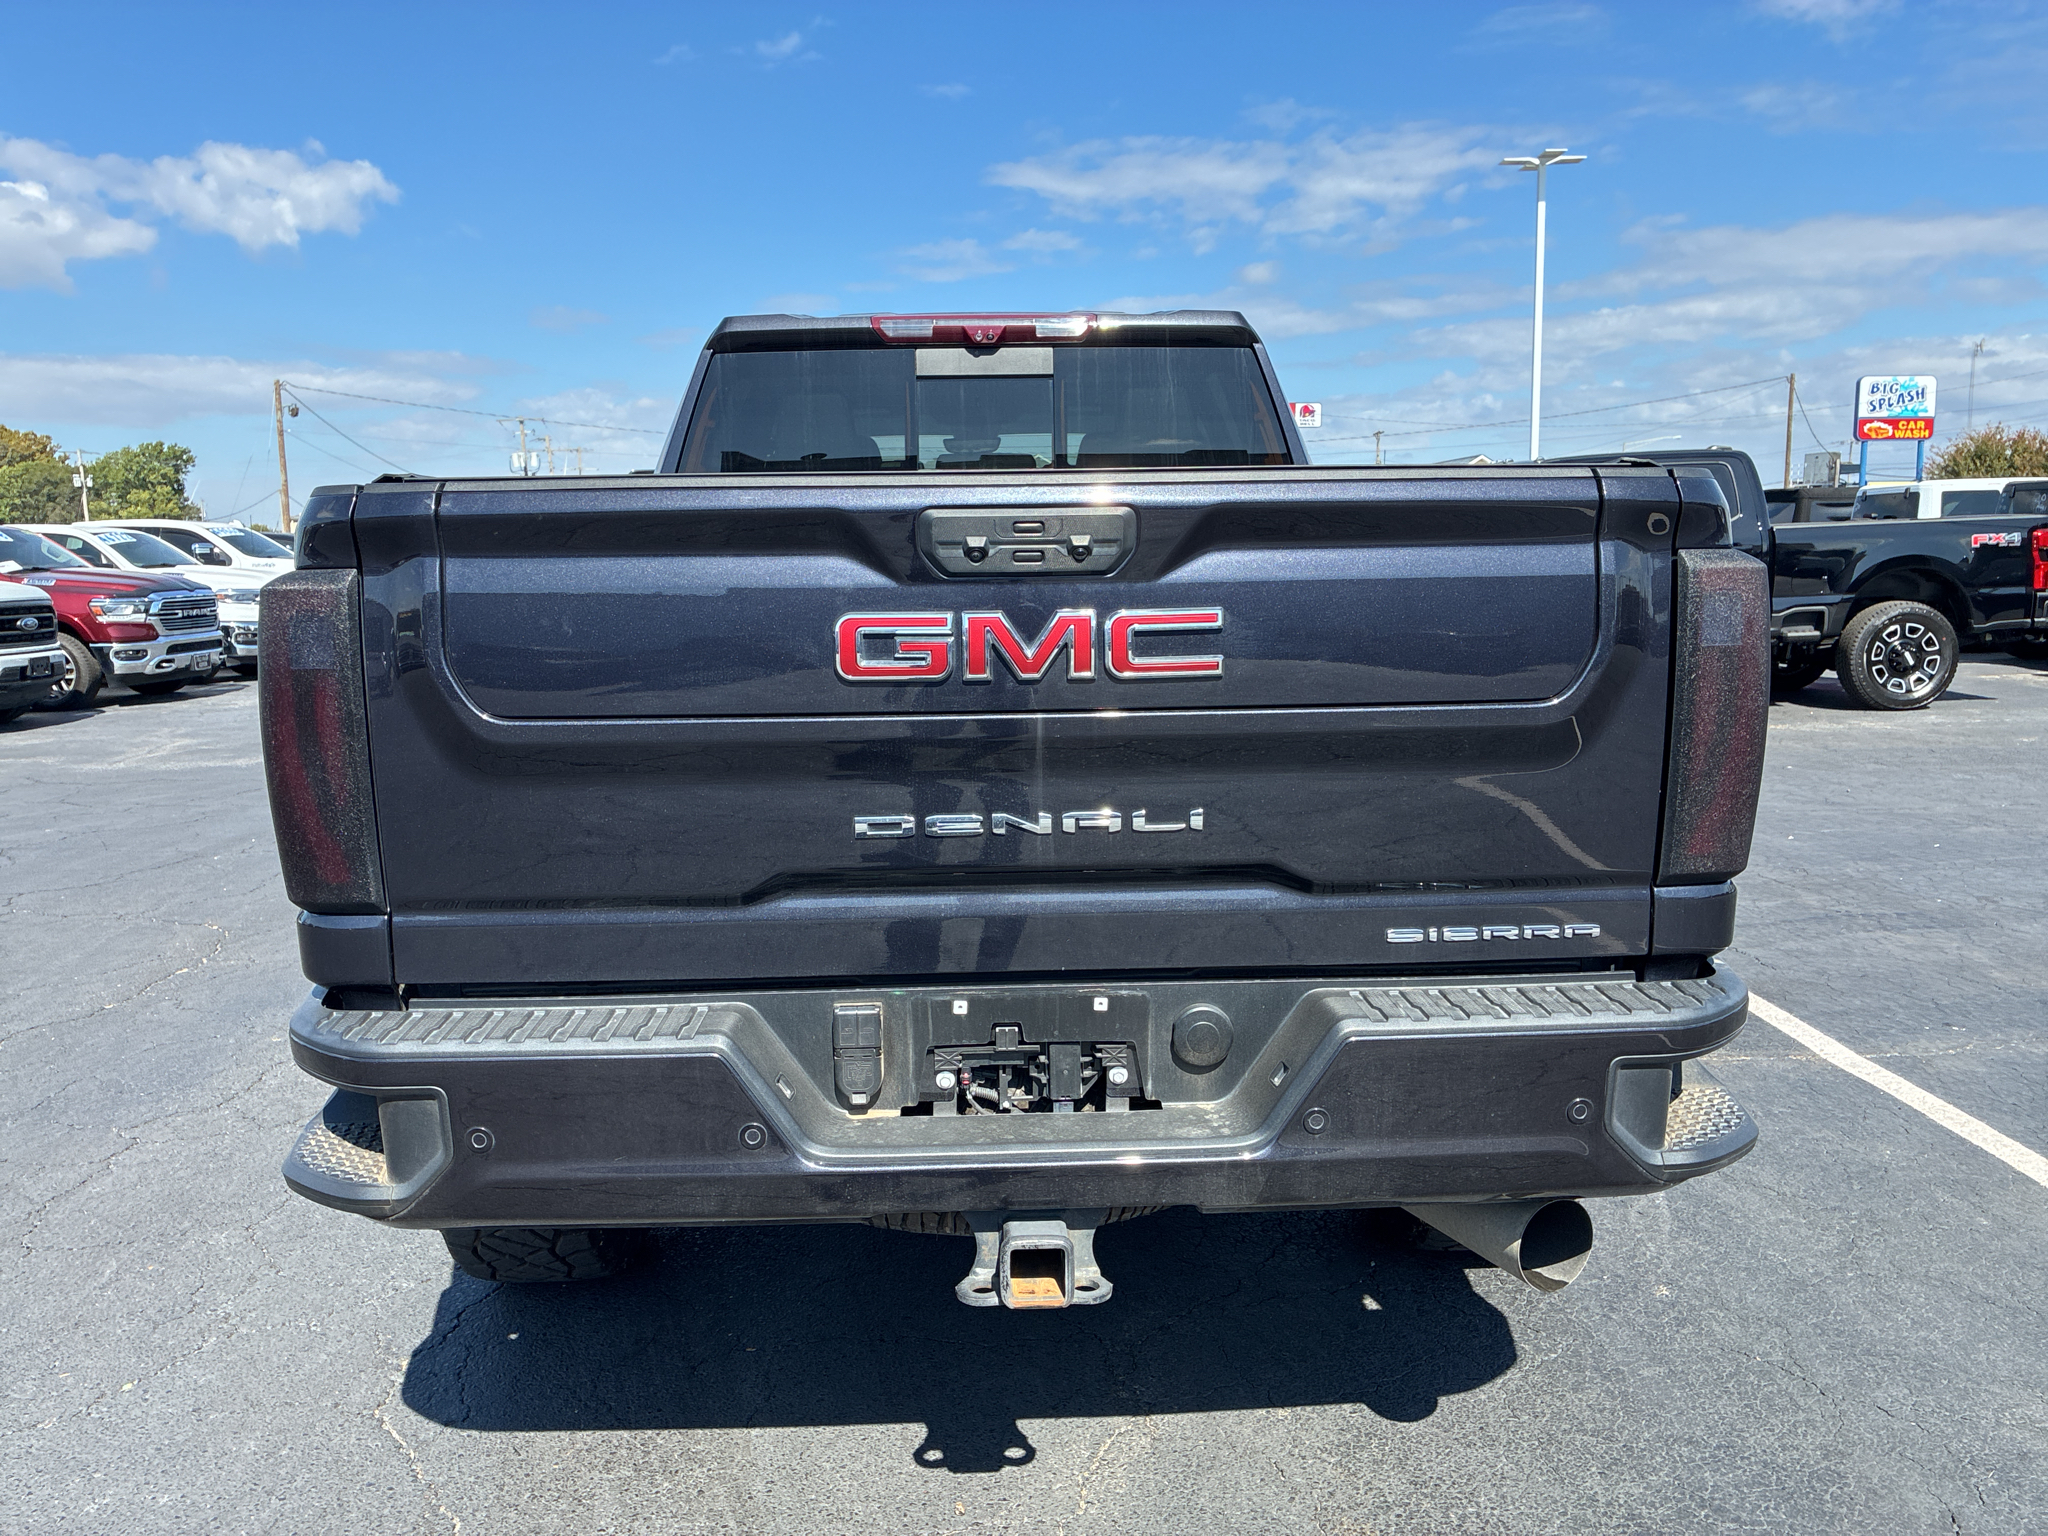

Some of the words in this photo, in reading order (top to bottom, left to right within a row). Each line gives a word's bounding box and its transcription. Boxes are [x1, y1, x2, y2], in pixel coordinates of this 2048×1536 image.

[1870, 383, 1900, 394] BIG
[1869, 387, 1926, 412] SPLASH
[1898, 421, 1925, 429] CAR
[1894, 430, 1929, 438] WASH
[1971, 532, 2021, 548] FX4
[183, 608, 210, 617] RAM
[835, 607, 1224, 682] GMC
[854, 806, 1204, 839] DENALI
[1386, 923, 1601, 943] SIERRA
